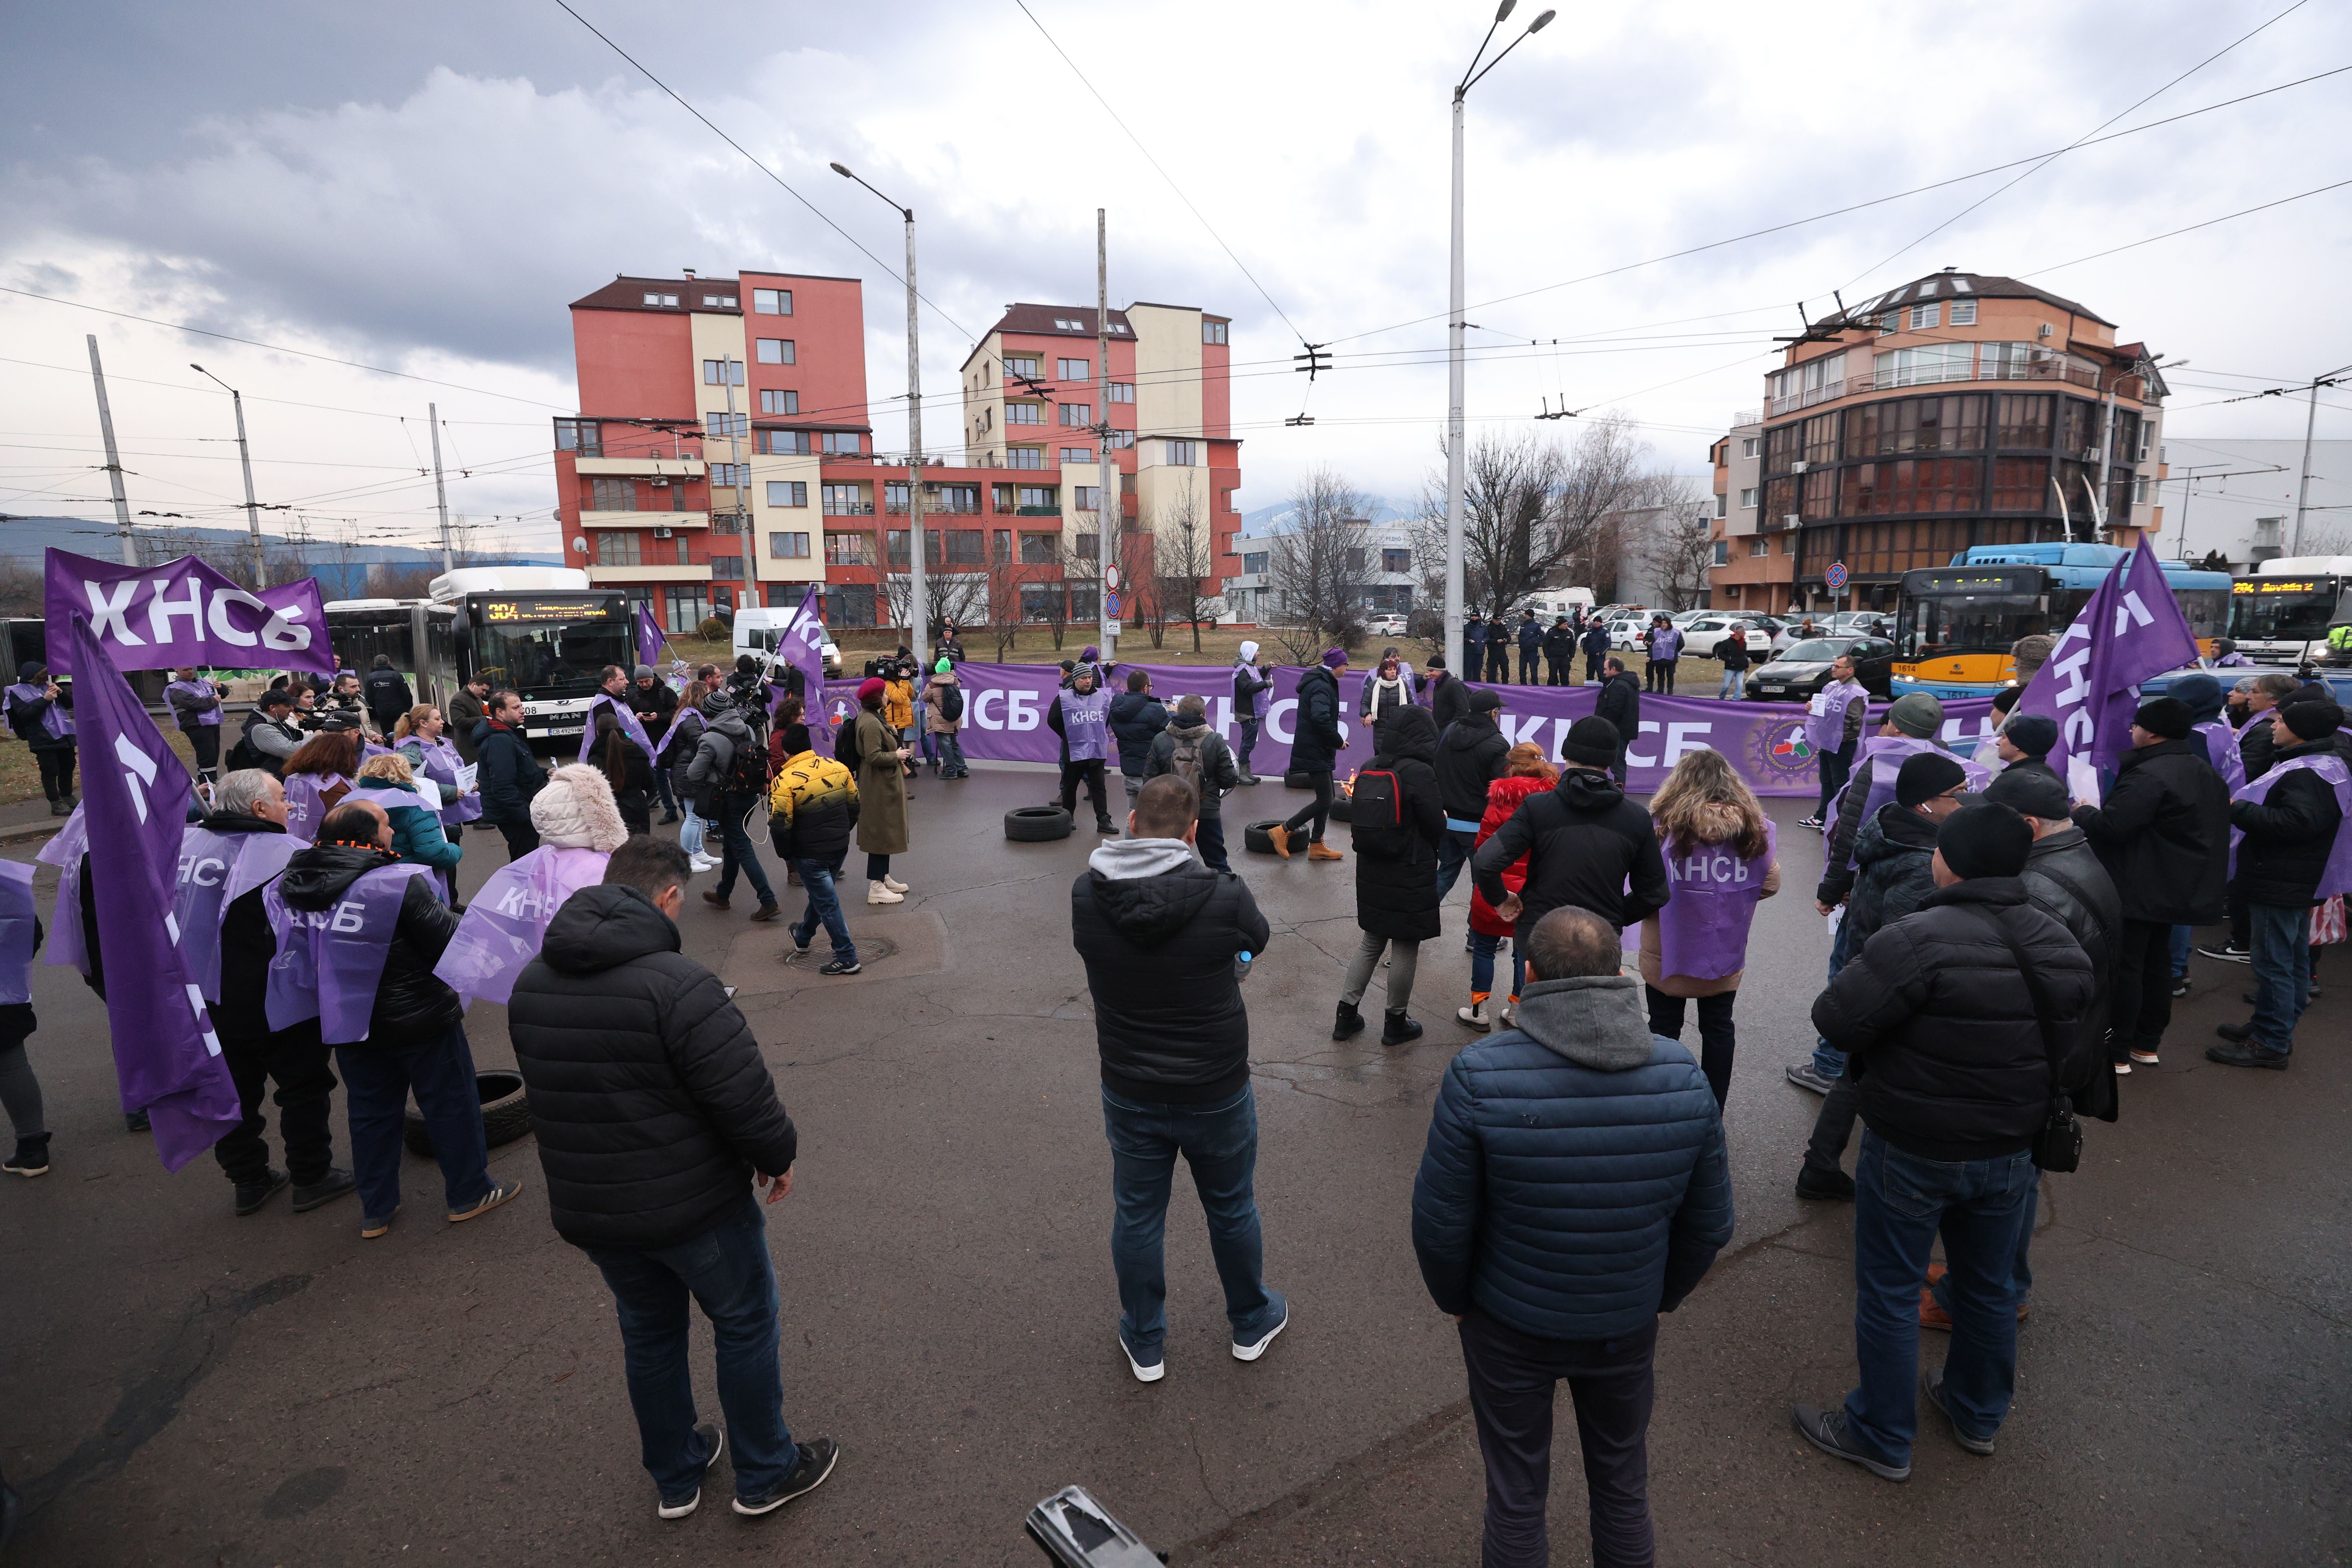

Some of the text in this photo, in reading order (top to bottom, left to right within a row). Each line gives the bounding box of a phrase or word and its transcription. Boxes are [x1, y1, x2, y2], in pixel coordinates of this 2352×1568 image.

[488, 603, 519, 620] 304
[549, 712, 581, 720] MAN
[1071, 710, 1104, 723] КНСБ
